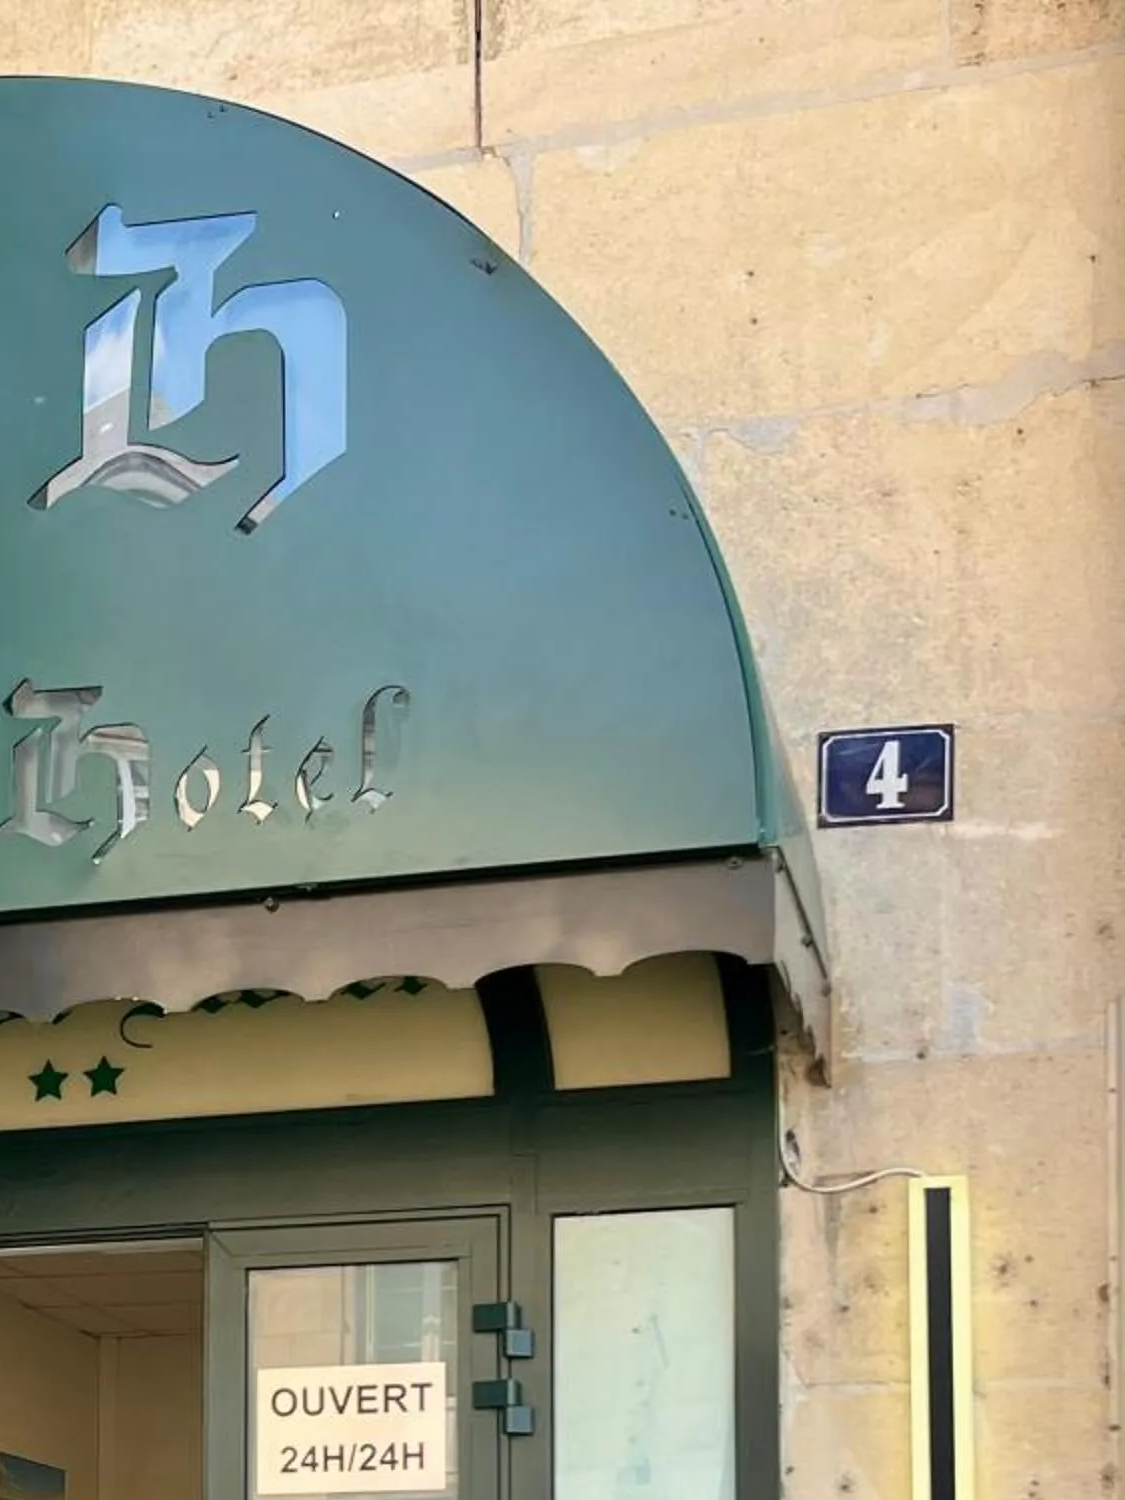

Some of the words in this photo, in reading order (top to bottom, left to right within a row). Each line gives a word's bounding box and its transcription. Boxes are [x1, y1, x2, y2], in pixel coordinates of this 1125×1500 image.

[866, 740, 908, 809] 4
[271, 1382, 433, 1417] OUVERT
[280, 1442, 425, 1474] 24H/24H
